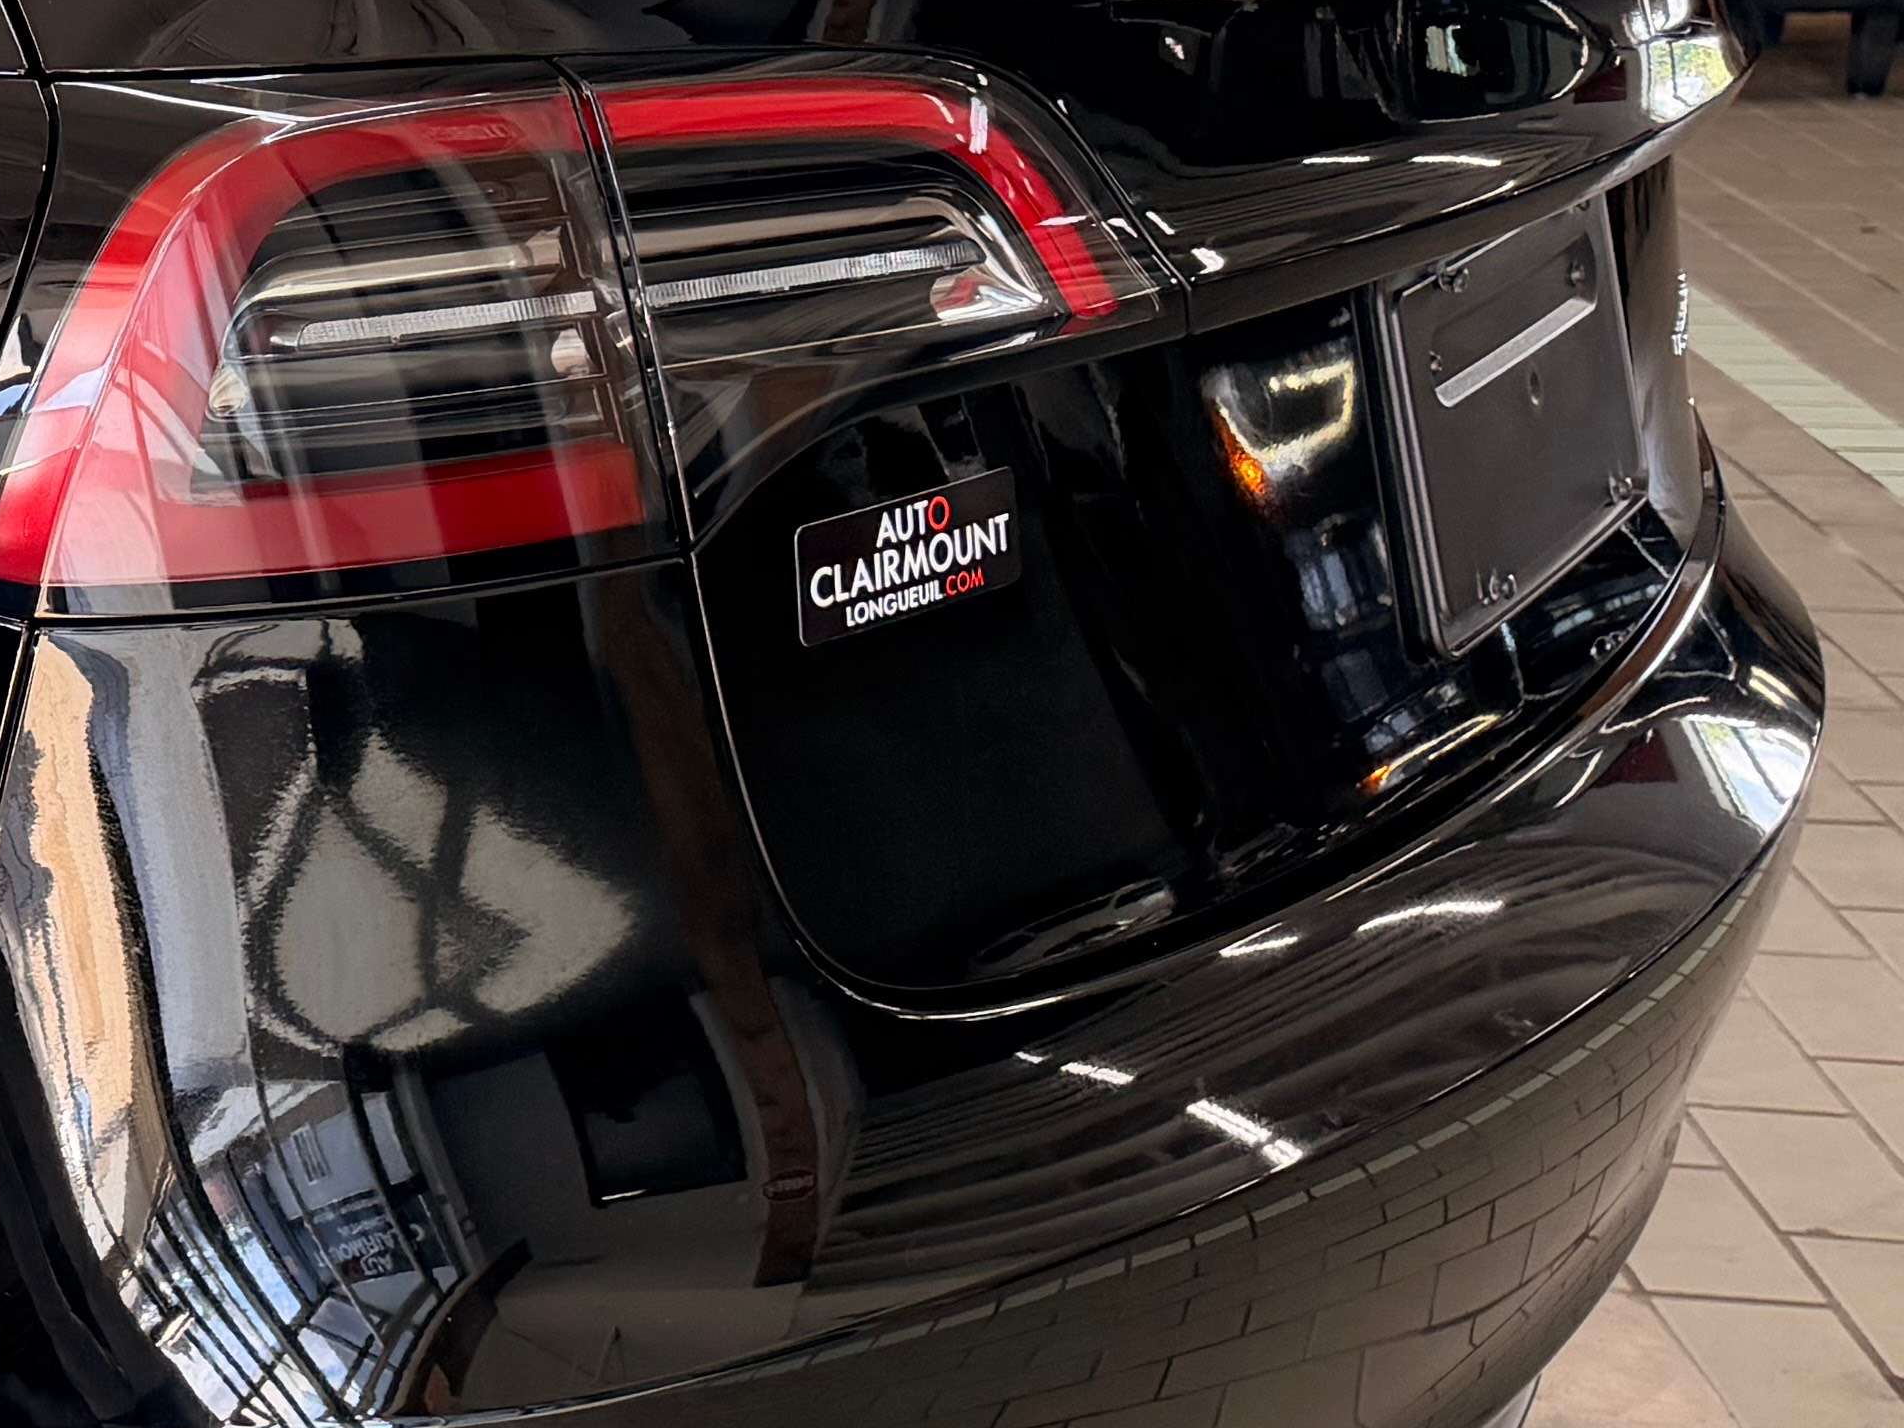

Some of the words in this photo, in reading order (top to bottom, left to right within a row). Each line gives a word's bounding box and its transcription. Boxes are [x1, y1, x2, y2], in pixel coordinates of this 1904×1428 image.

[876, 495, 952, 548] AUTO
[809, 512, 1010, 609] CLAIRMOUNT
[845, 566, 985, 628] LONGUEUIL.COM
